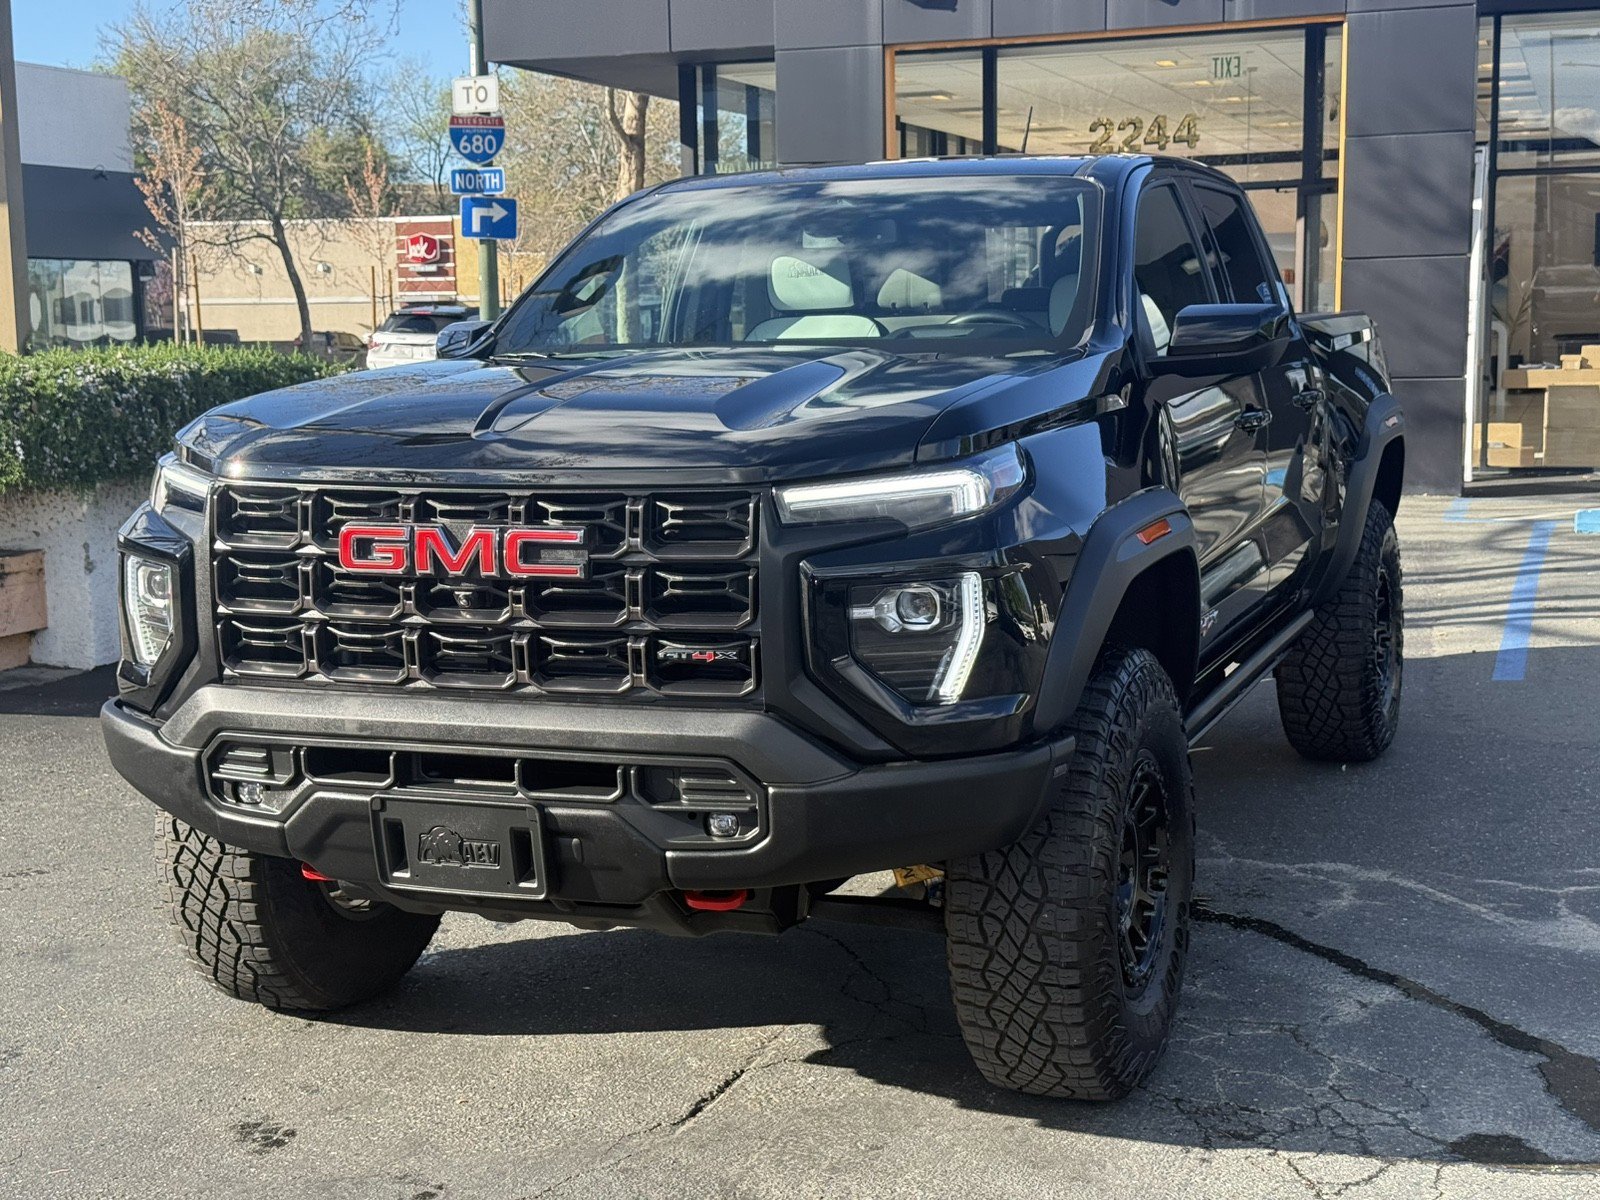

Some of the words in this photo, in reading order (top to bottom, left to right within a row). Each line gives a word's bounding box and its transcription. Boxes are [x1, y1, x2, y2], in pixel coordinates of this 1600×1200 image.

[462, 85, 488, 104] TO
[453, 116, 501, 125] INTERSTATE
[1089, 113, 1200, 153] 2244
[459, 135, 497, 154] 680
[455, 173, 500, 190] NORTH
[338, 522, 586, 579] GMC
[463, 841, 498, 865] AEV
